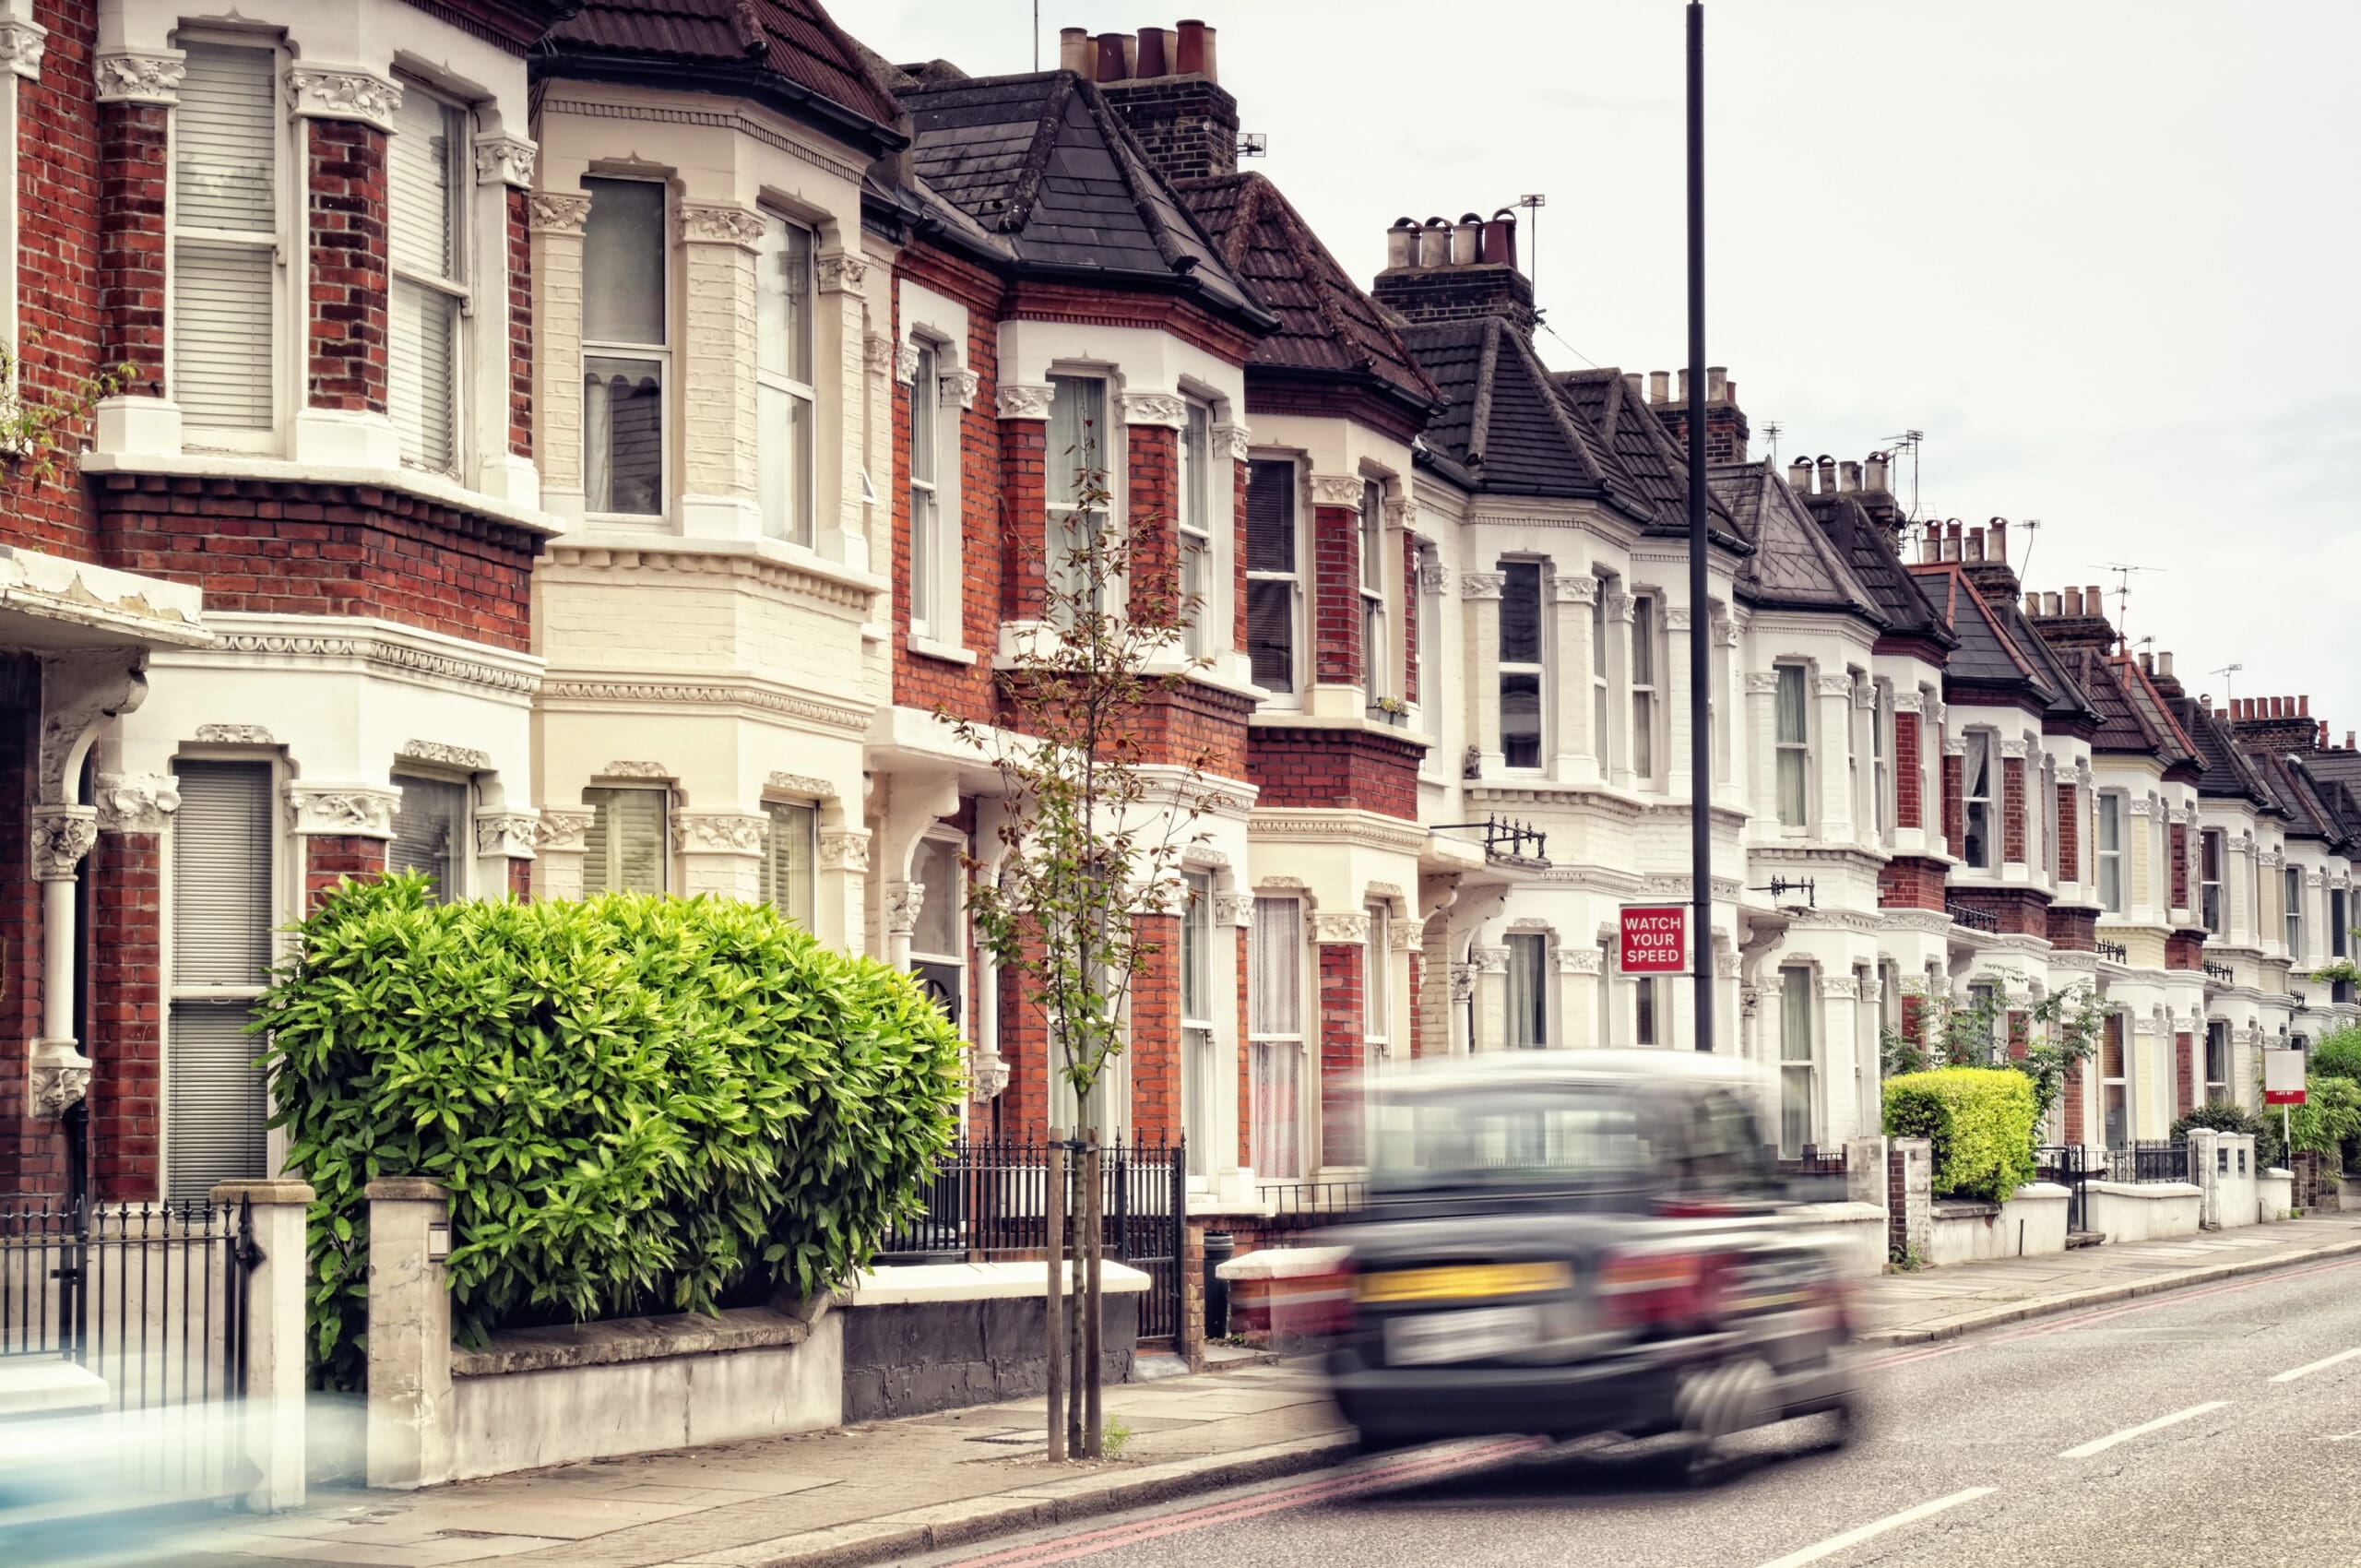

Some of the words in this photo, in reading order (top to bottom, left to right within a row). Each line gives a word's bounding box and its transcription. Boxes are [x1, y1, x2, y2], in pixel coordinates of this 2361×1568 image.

[1625, 917, 1681, 930] WATCH
[1631, 933, 1675, 946] YOUR
[1627, 949, 1679, 962] SPEED
